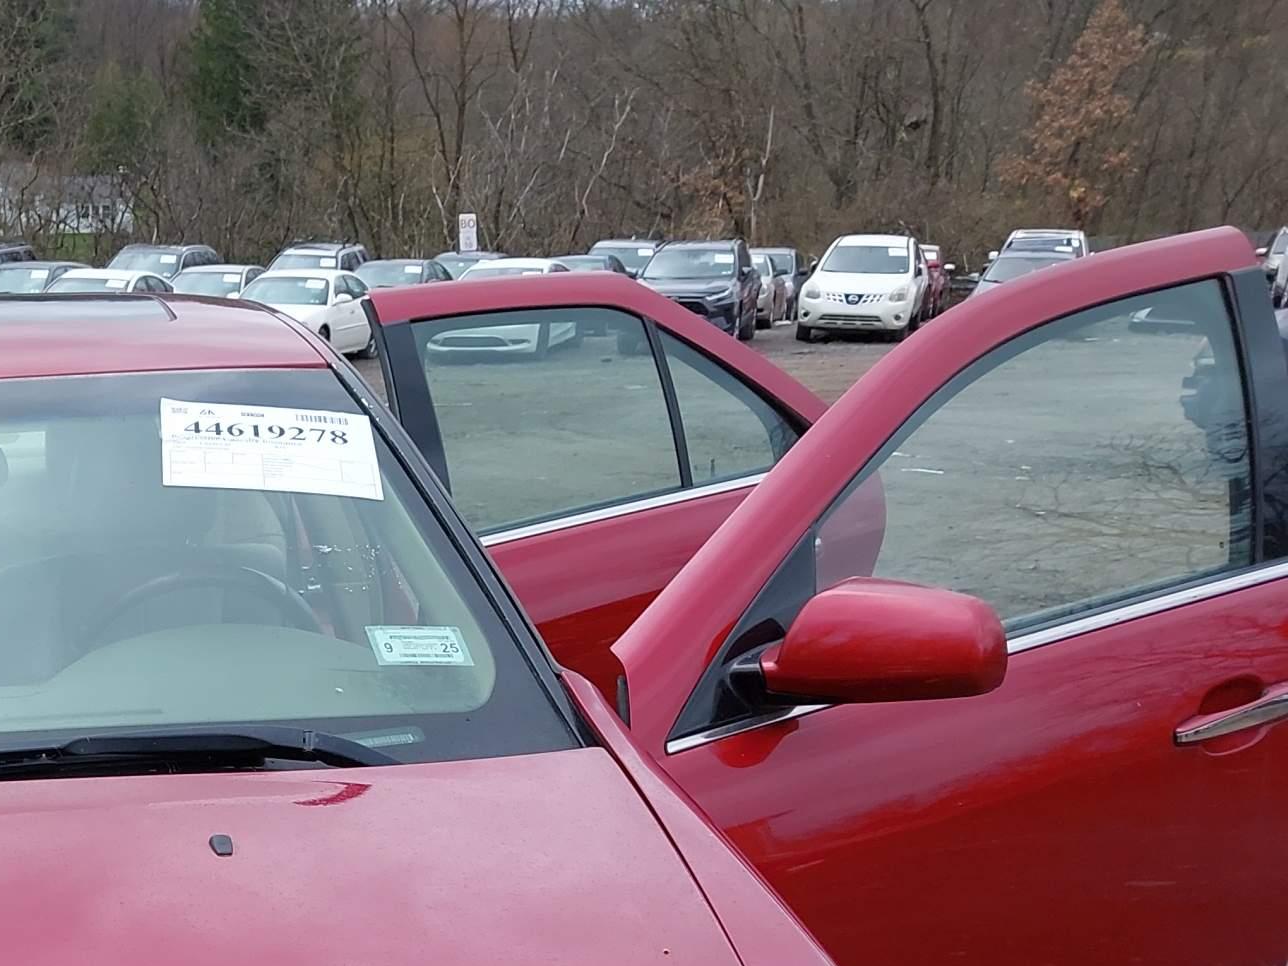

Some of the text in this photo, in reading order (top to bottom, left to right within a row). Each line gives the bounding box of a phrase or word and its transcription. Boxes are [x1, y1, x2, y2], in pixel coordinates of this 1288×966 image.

[183, 419, 349, 446] 44619278
[383, 641, 394, 654] 9
[440, 642, 460, 654] 25
